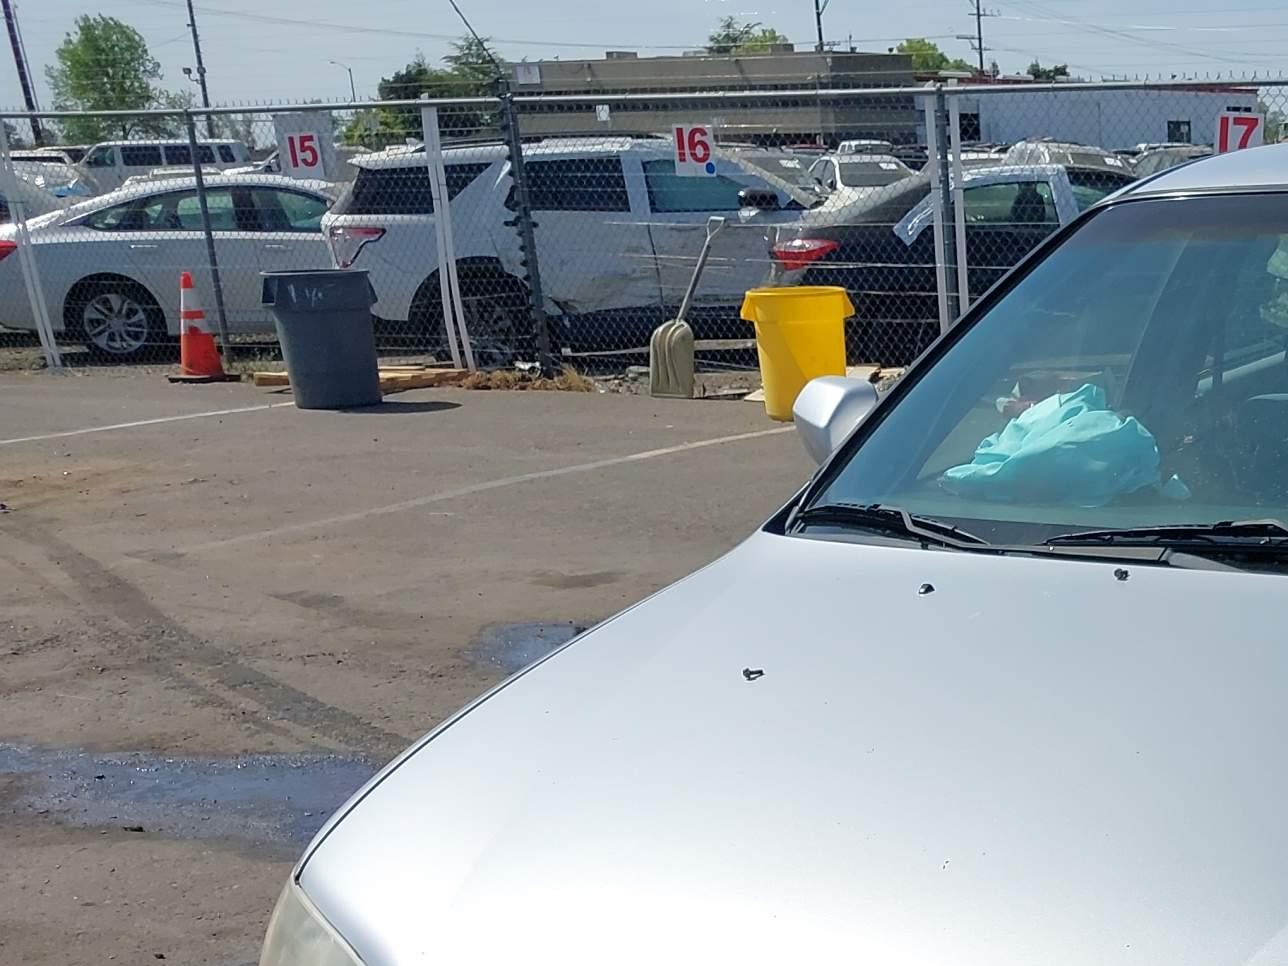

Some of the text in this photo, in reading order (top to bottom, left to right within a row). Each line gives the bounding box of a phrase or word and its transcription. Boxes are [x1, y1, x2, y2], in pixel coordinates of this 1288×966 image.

[288, 135, 318, 168] 15
[676, 127, 710, 163] 16
[1219, 116, 1259, 153] 17
